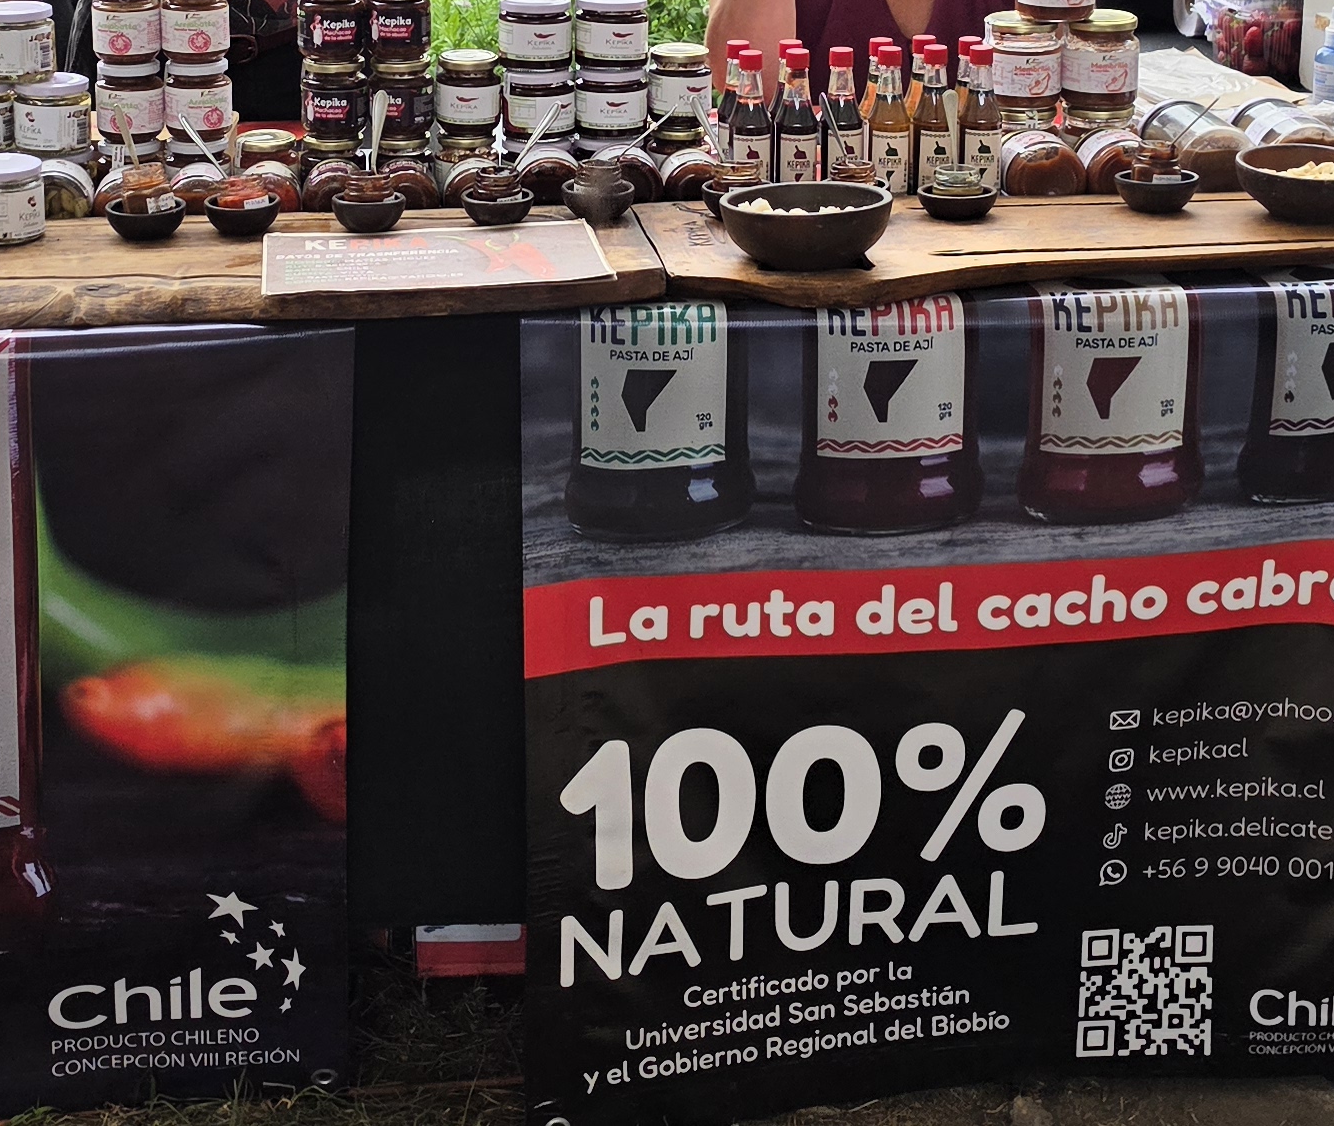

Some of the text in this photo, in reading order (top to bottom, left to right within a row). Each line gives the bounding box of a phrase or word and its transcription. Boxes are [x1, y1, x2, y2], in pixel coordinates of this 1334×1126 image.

[323, 19, 356, 30] Kepika
[378, 16, 411, 27] Kepika
[314, 97, 347, 108] Kepika
[787, 160, 810, 168] KEPIKA
[878, 157, 902, 165] KEPIKA
[971, 154, 994, 163] KEPIKA
[304, 237, 429, 251] KEPIKA
[1051, 288, 1179, 333] KEPIKA
[589, 304, 717, 346] KEPIKA
[850, 336, 934, 353] PASTA DE AJÍ
[1075, 333, 1159, 350] PASTA DE AJÍ
[609, 347, 695, 361] PASTA DE AJÍ
[938, 402, 953, 411] 120
[1160, 399, 1174, 409] 120
[696, 412, 711, 421] 120
[939, 411, 952, 421] grs
[698, 421, 713, 431] grs
[588, 595, 668, 647] La
[689, 589, 836, 638] ruta
[856, 581, 959, 635] del
[977, 574, 1168, 631] cacho
[1148, 738, 1249, 766] kepikacl
[1146, 777, 1326, 802] www.kepika.cl
[559, 708, 1047, 891] 100%
[1142, 858, 1187, 881] +56
[1194, 857, 1209, 877] 9
[1216, 855, 1281, 877] 9040
[560, 870, 1039, 988] NATURAL
[683, 960, 913, 1008] Certificado por la
[48, 967, 258, 1030] Chile
[625, 984, 971, 1051] Universidad San Sebastián
[51, 1027, 260, 1055] PRODUCTO CHILENO
[1249, 1030, 1317, 1042] PRODUCTO
[582, 1008, 1011, 1094] y el Gobierno Regional del Biobío
[1248, 1041, 1327, 1055] CONCEPCIÓN
[51, 1046, 301, 1077] CONCEPCIÓN VIII REGIÓN
